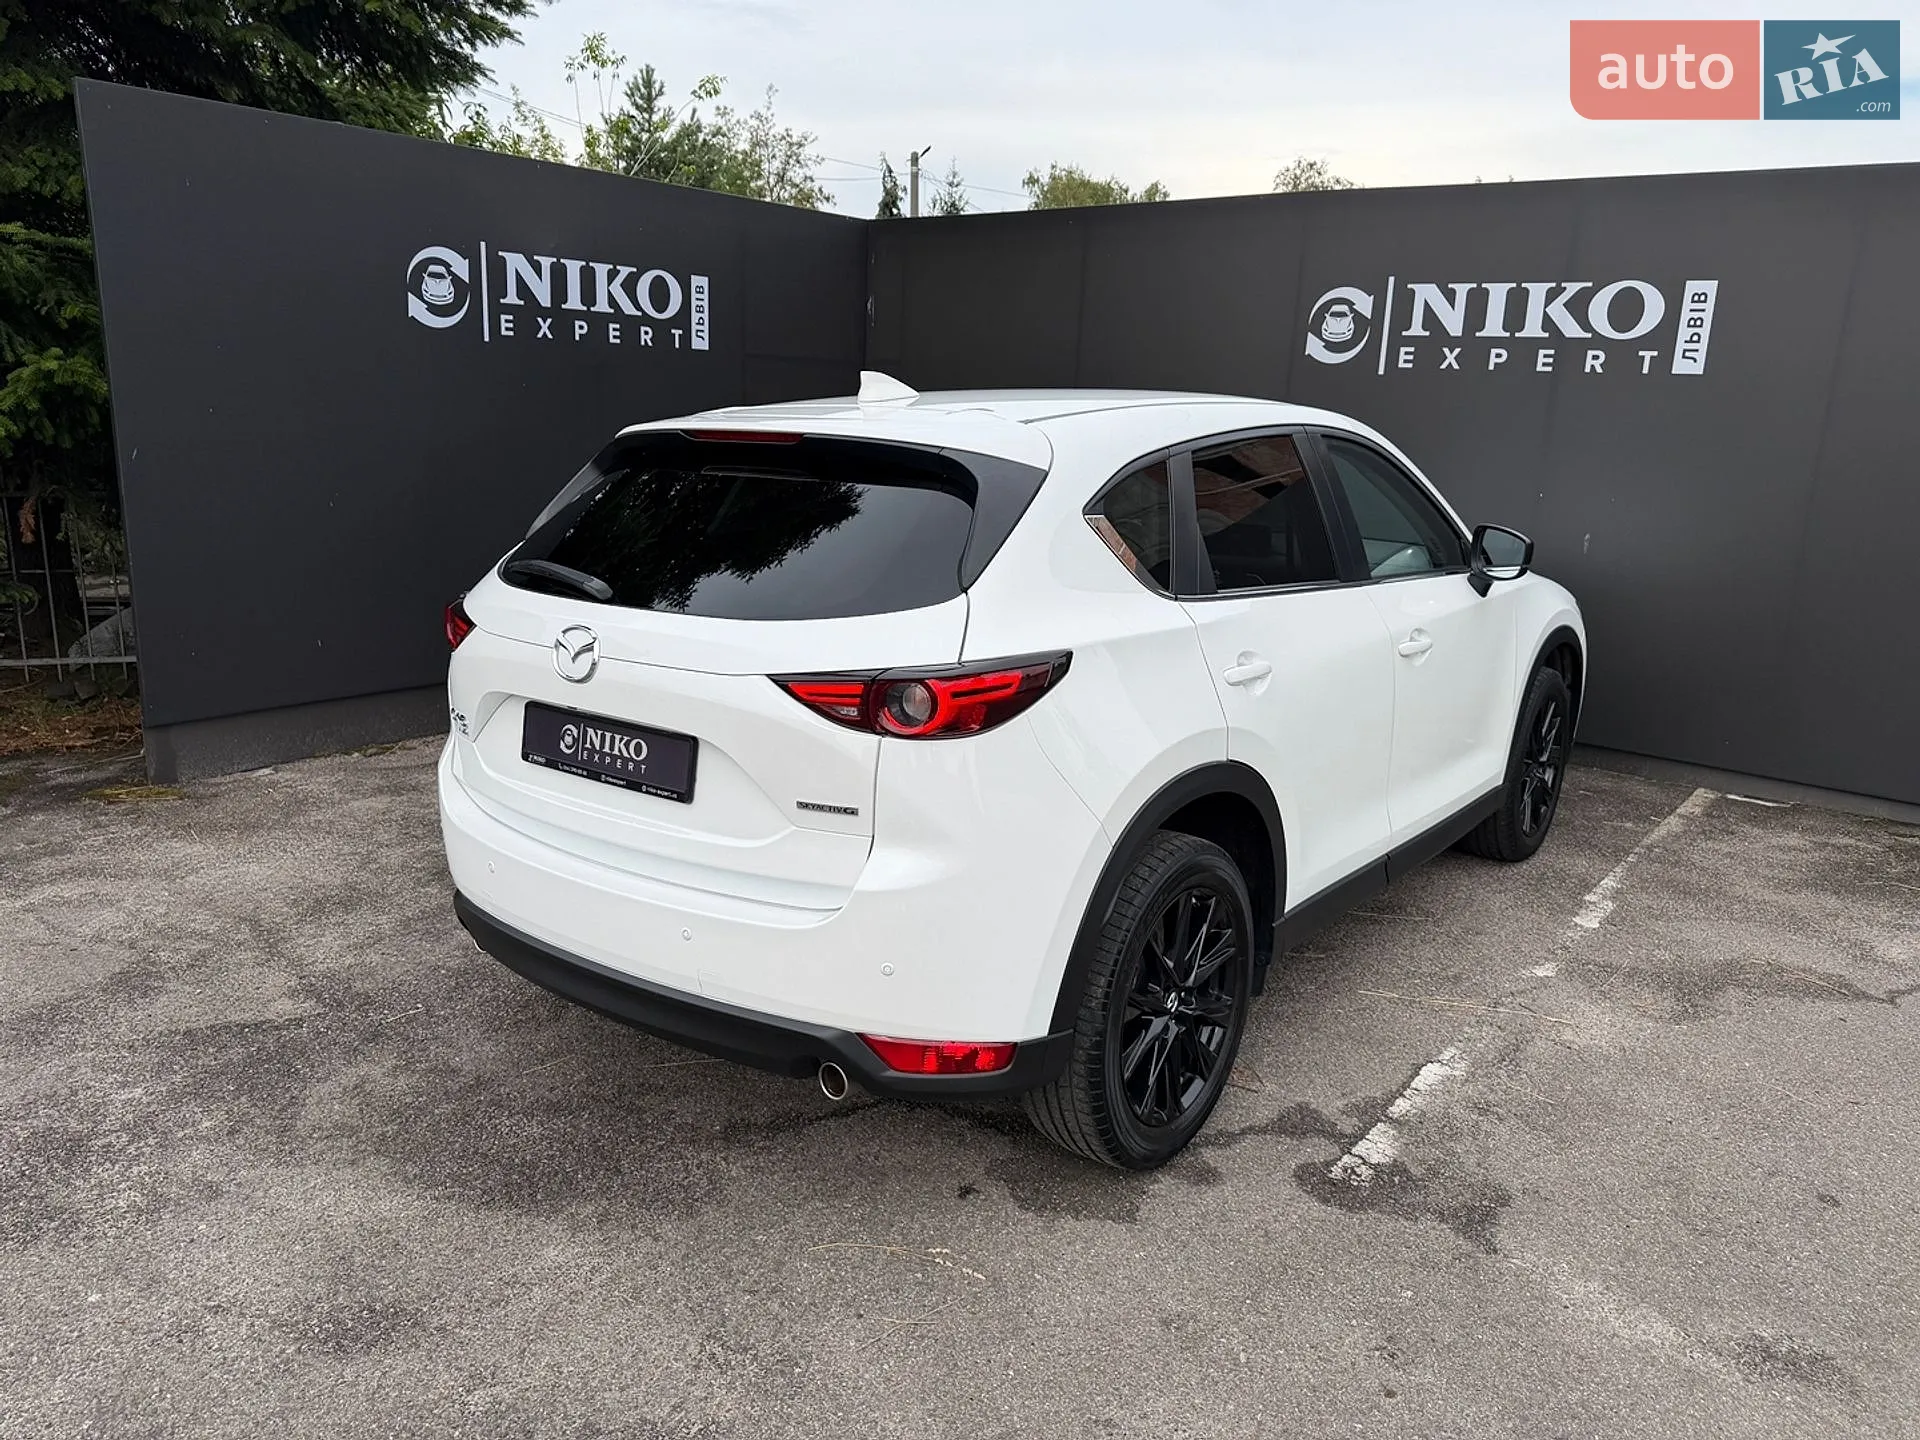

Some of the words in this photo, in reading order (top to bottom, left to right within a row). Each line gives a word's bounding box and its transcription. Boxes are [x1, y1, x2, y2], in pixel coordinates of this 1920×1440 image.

[498, 251, 683, 320] NIKO
[500, 314, 683, 349] EXPERT
[694, 285, 706, 342] ЛЬВІВ
[1401, 279, 1666, 340] NIKO
[1681, 292, 1708, 363] ЛЬВІВ
[1397, 346, 1658, 374] EXPERT
[582, 751, 647, 775] EXPERT
[584, 727, 648, 761] NIKO
